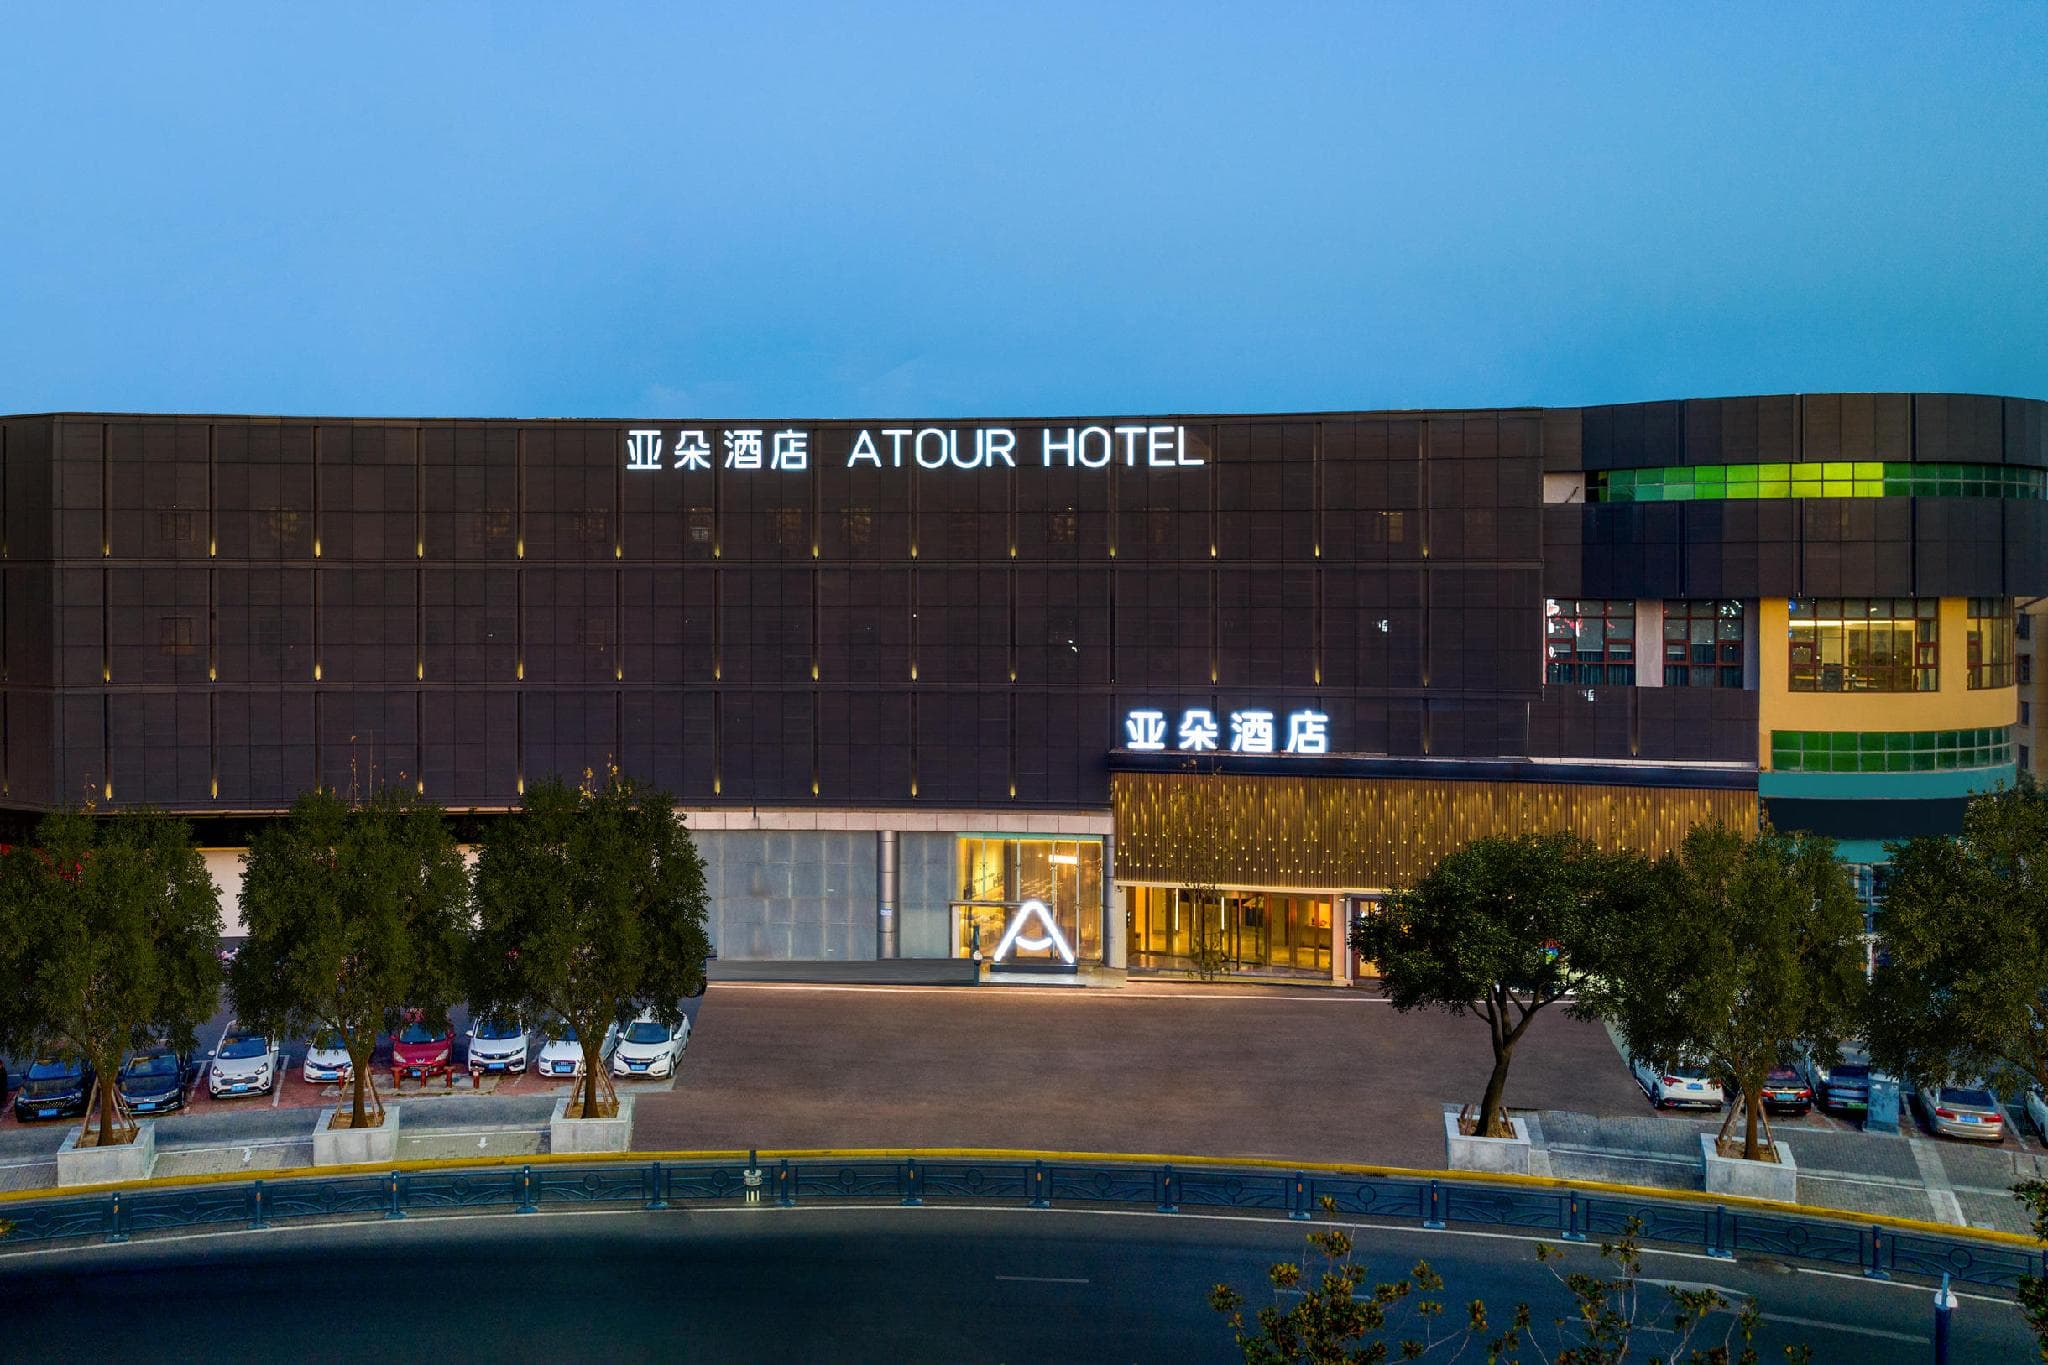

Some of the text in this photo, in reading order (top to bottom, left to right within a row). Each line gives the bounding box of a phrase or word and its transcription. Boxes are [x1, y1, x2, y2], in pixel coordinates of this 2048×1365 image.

[626, 429, 808, 470] 亚朵酒店
[847, 426, 1205, 469] ATOUR HOTEL
[1126, 710, 1328, 753] 亚朵酒店
